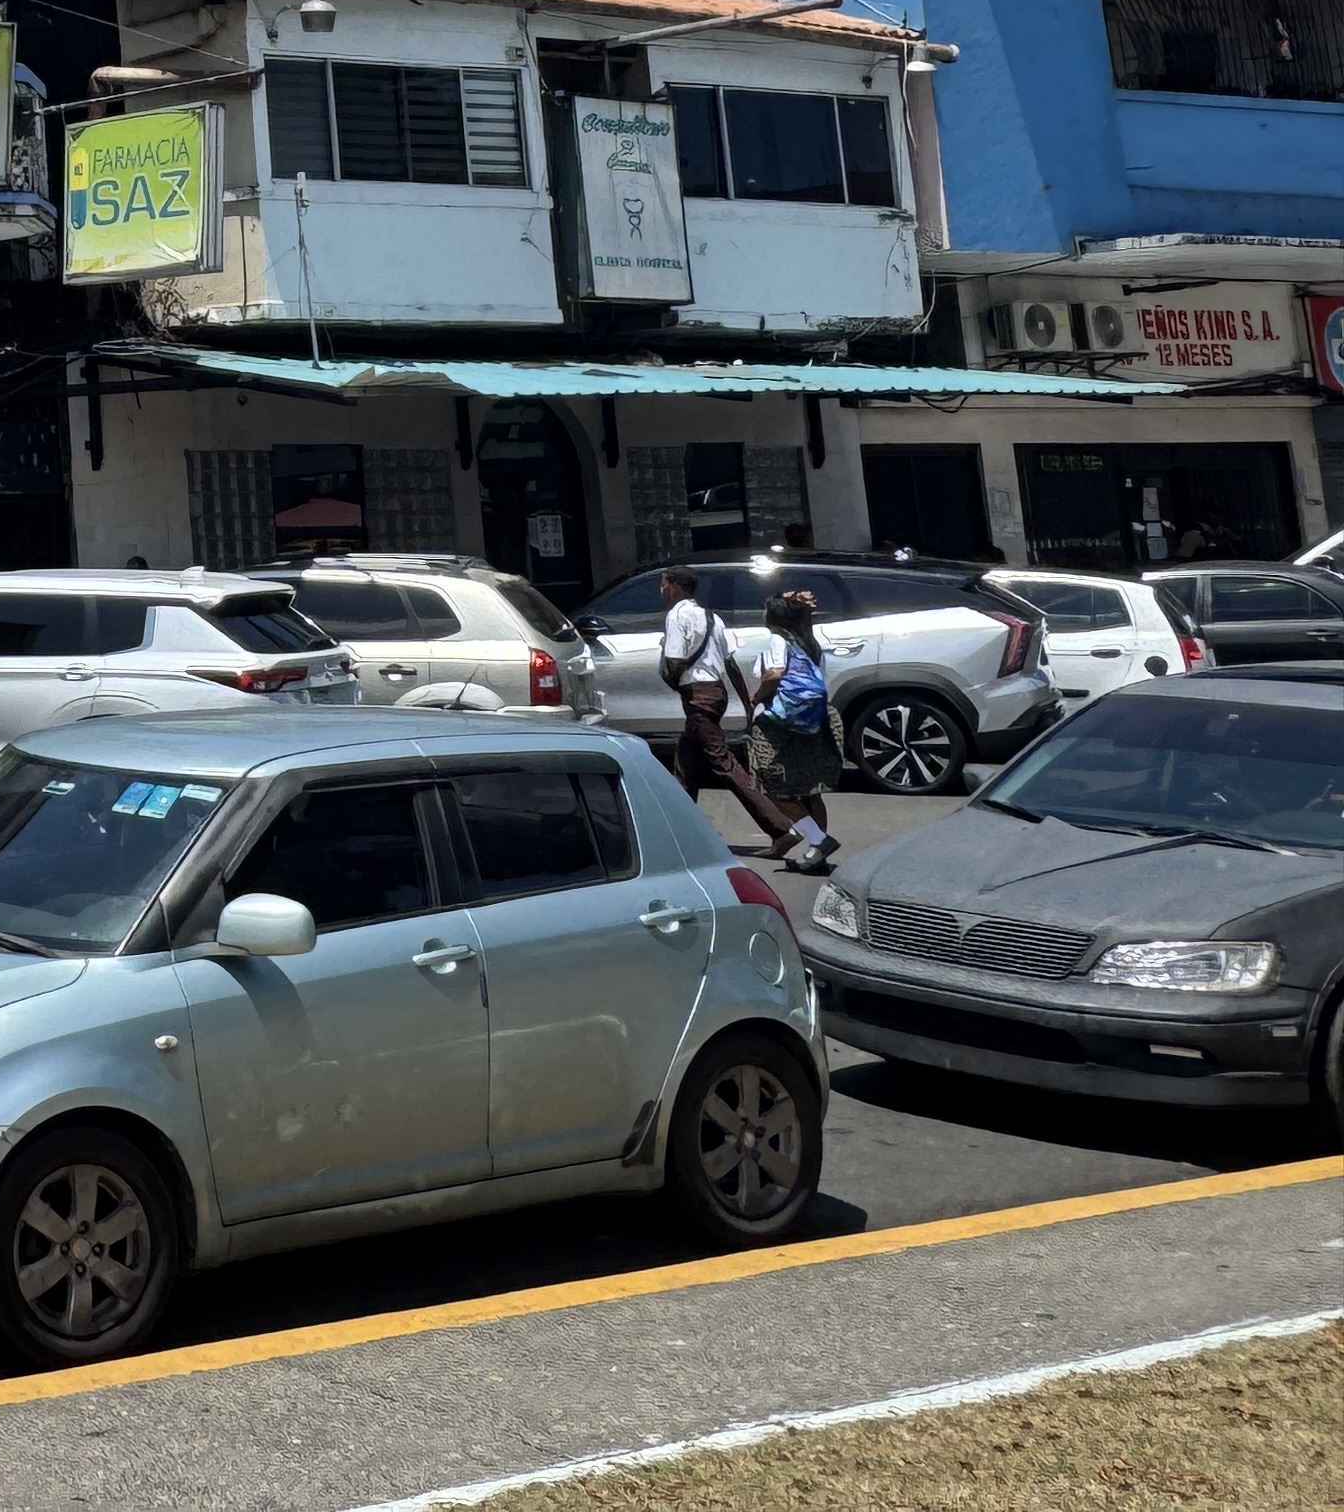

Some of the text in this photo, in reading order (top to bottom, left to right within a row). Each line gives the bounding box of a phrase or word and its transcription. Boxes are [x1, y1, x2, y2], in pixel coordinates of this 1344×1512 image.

[93, 137, 190, 175] FARMACIA
[91, 170, 190, 226] SAZ
[1194, 310, 1238, 340] KING
[1155, 344, 1174, 366] 12
[1176, 344, 1233, 366] MESES
